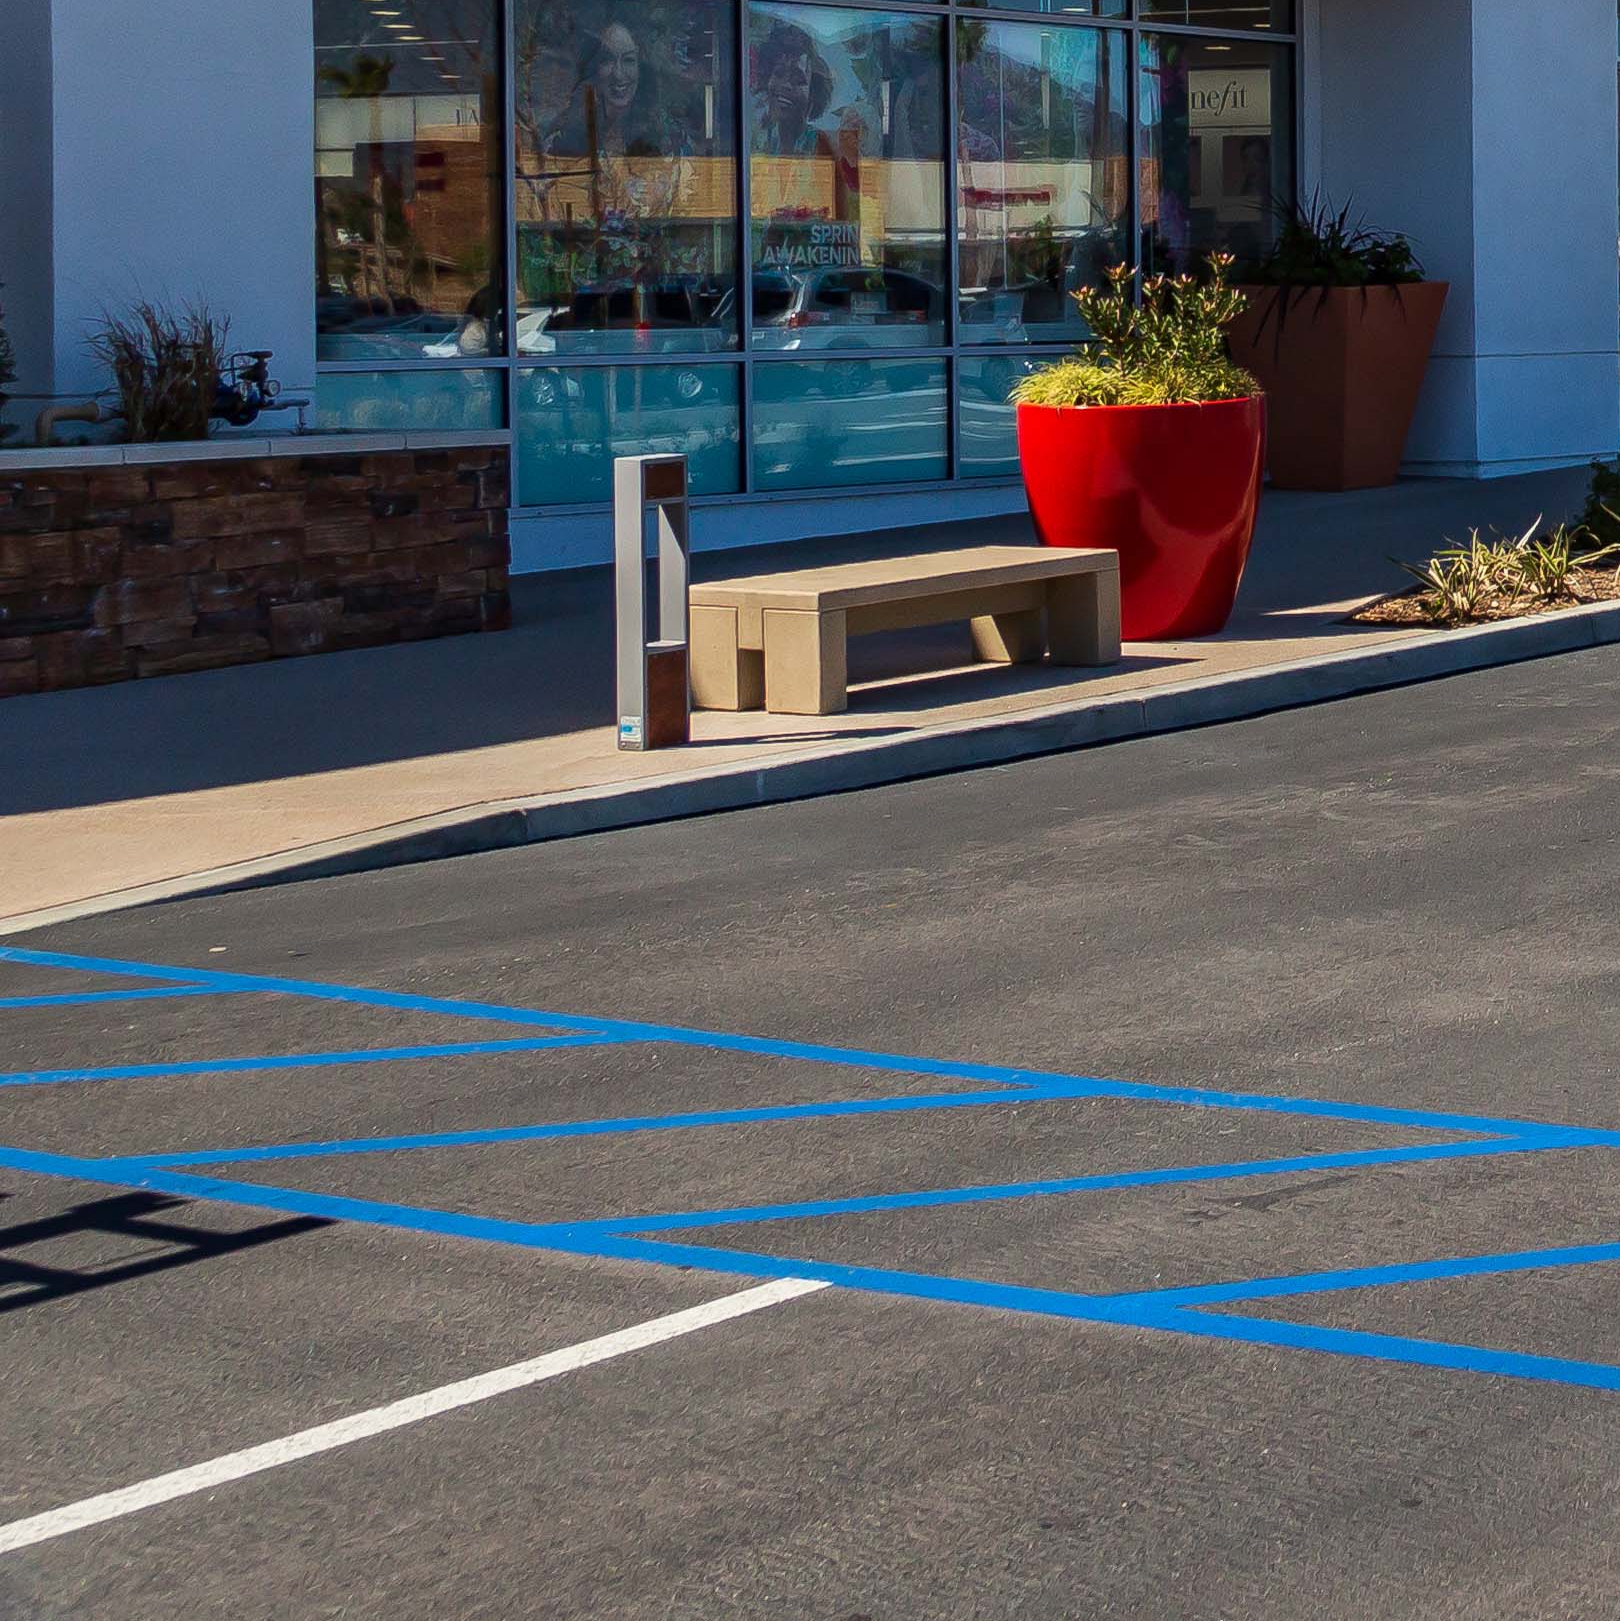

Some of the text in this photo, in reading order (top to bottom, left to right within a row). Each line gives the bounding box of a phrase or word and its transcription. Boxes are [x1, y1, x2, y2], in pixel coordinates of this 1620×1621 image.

[1189, 80, 1249, 117] nefit
[810, 224, 861, 245] SPRIN
[762, 246, 862, 266] AWAKENIN
